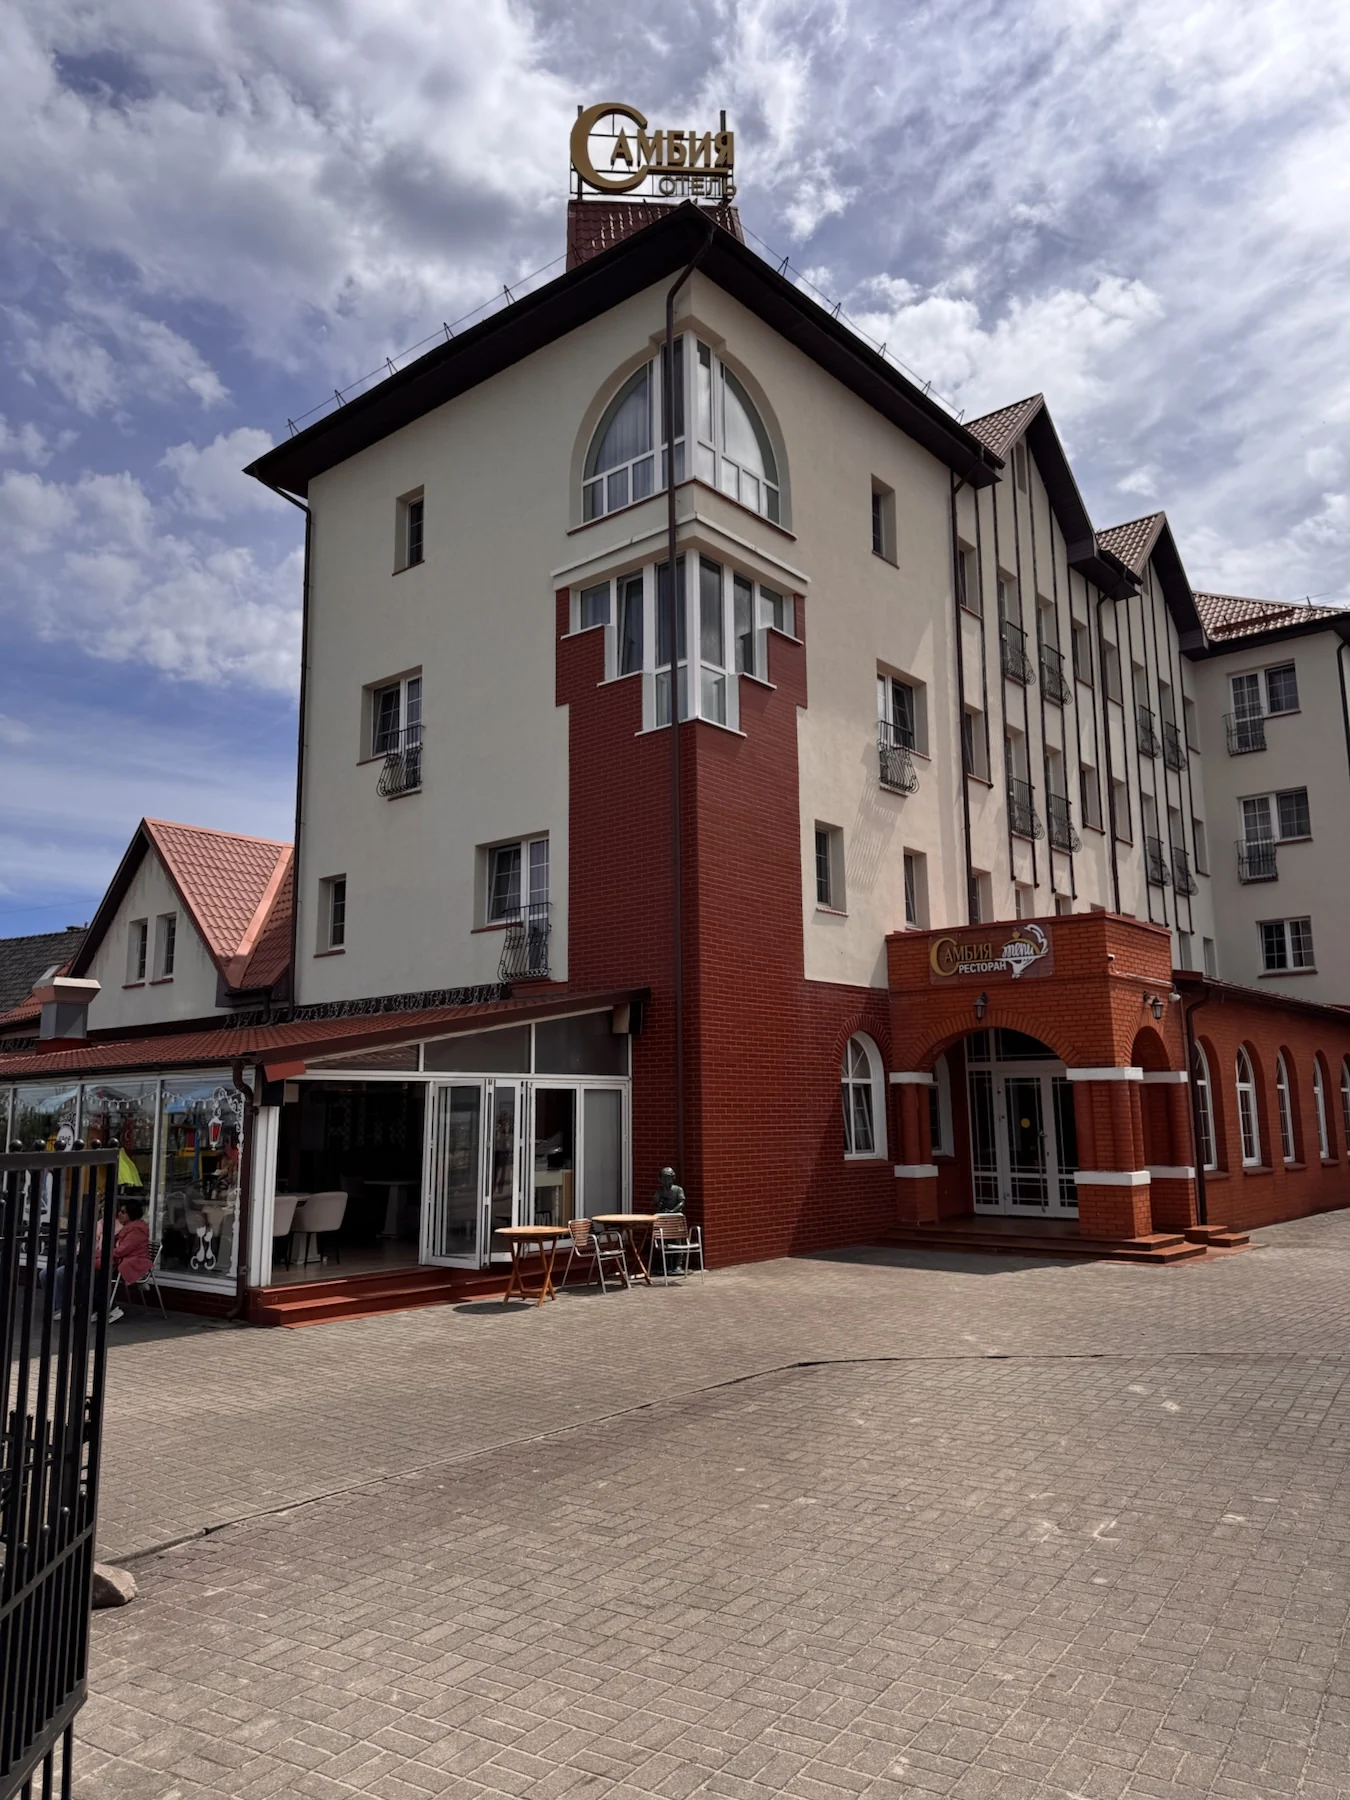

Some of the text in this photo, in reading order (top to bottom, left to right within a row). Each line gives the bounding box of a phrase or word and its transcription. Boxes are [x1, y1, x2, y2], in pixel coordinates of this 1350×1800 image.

[570, 102, 734, 194] САМБИЯ
[659, 176, 737, 197] ОТЕЛЬ
[930, 937, 992, 976] САМБИЯ
[958, 961, 1007, 974] РЕСТОРАН
